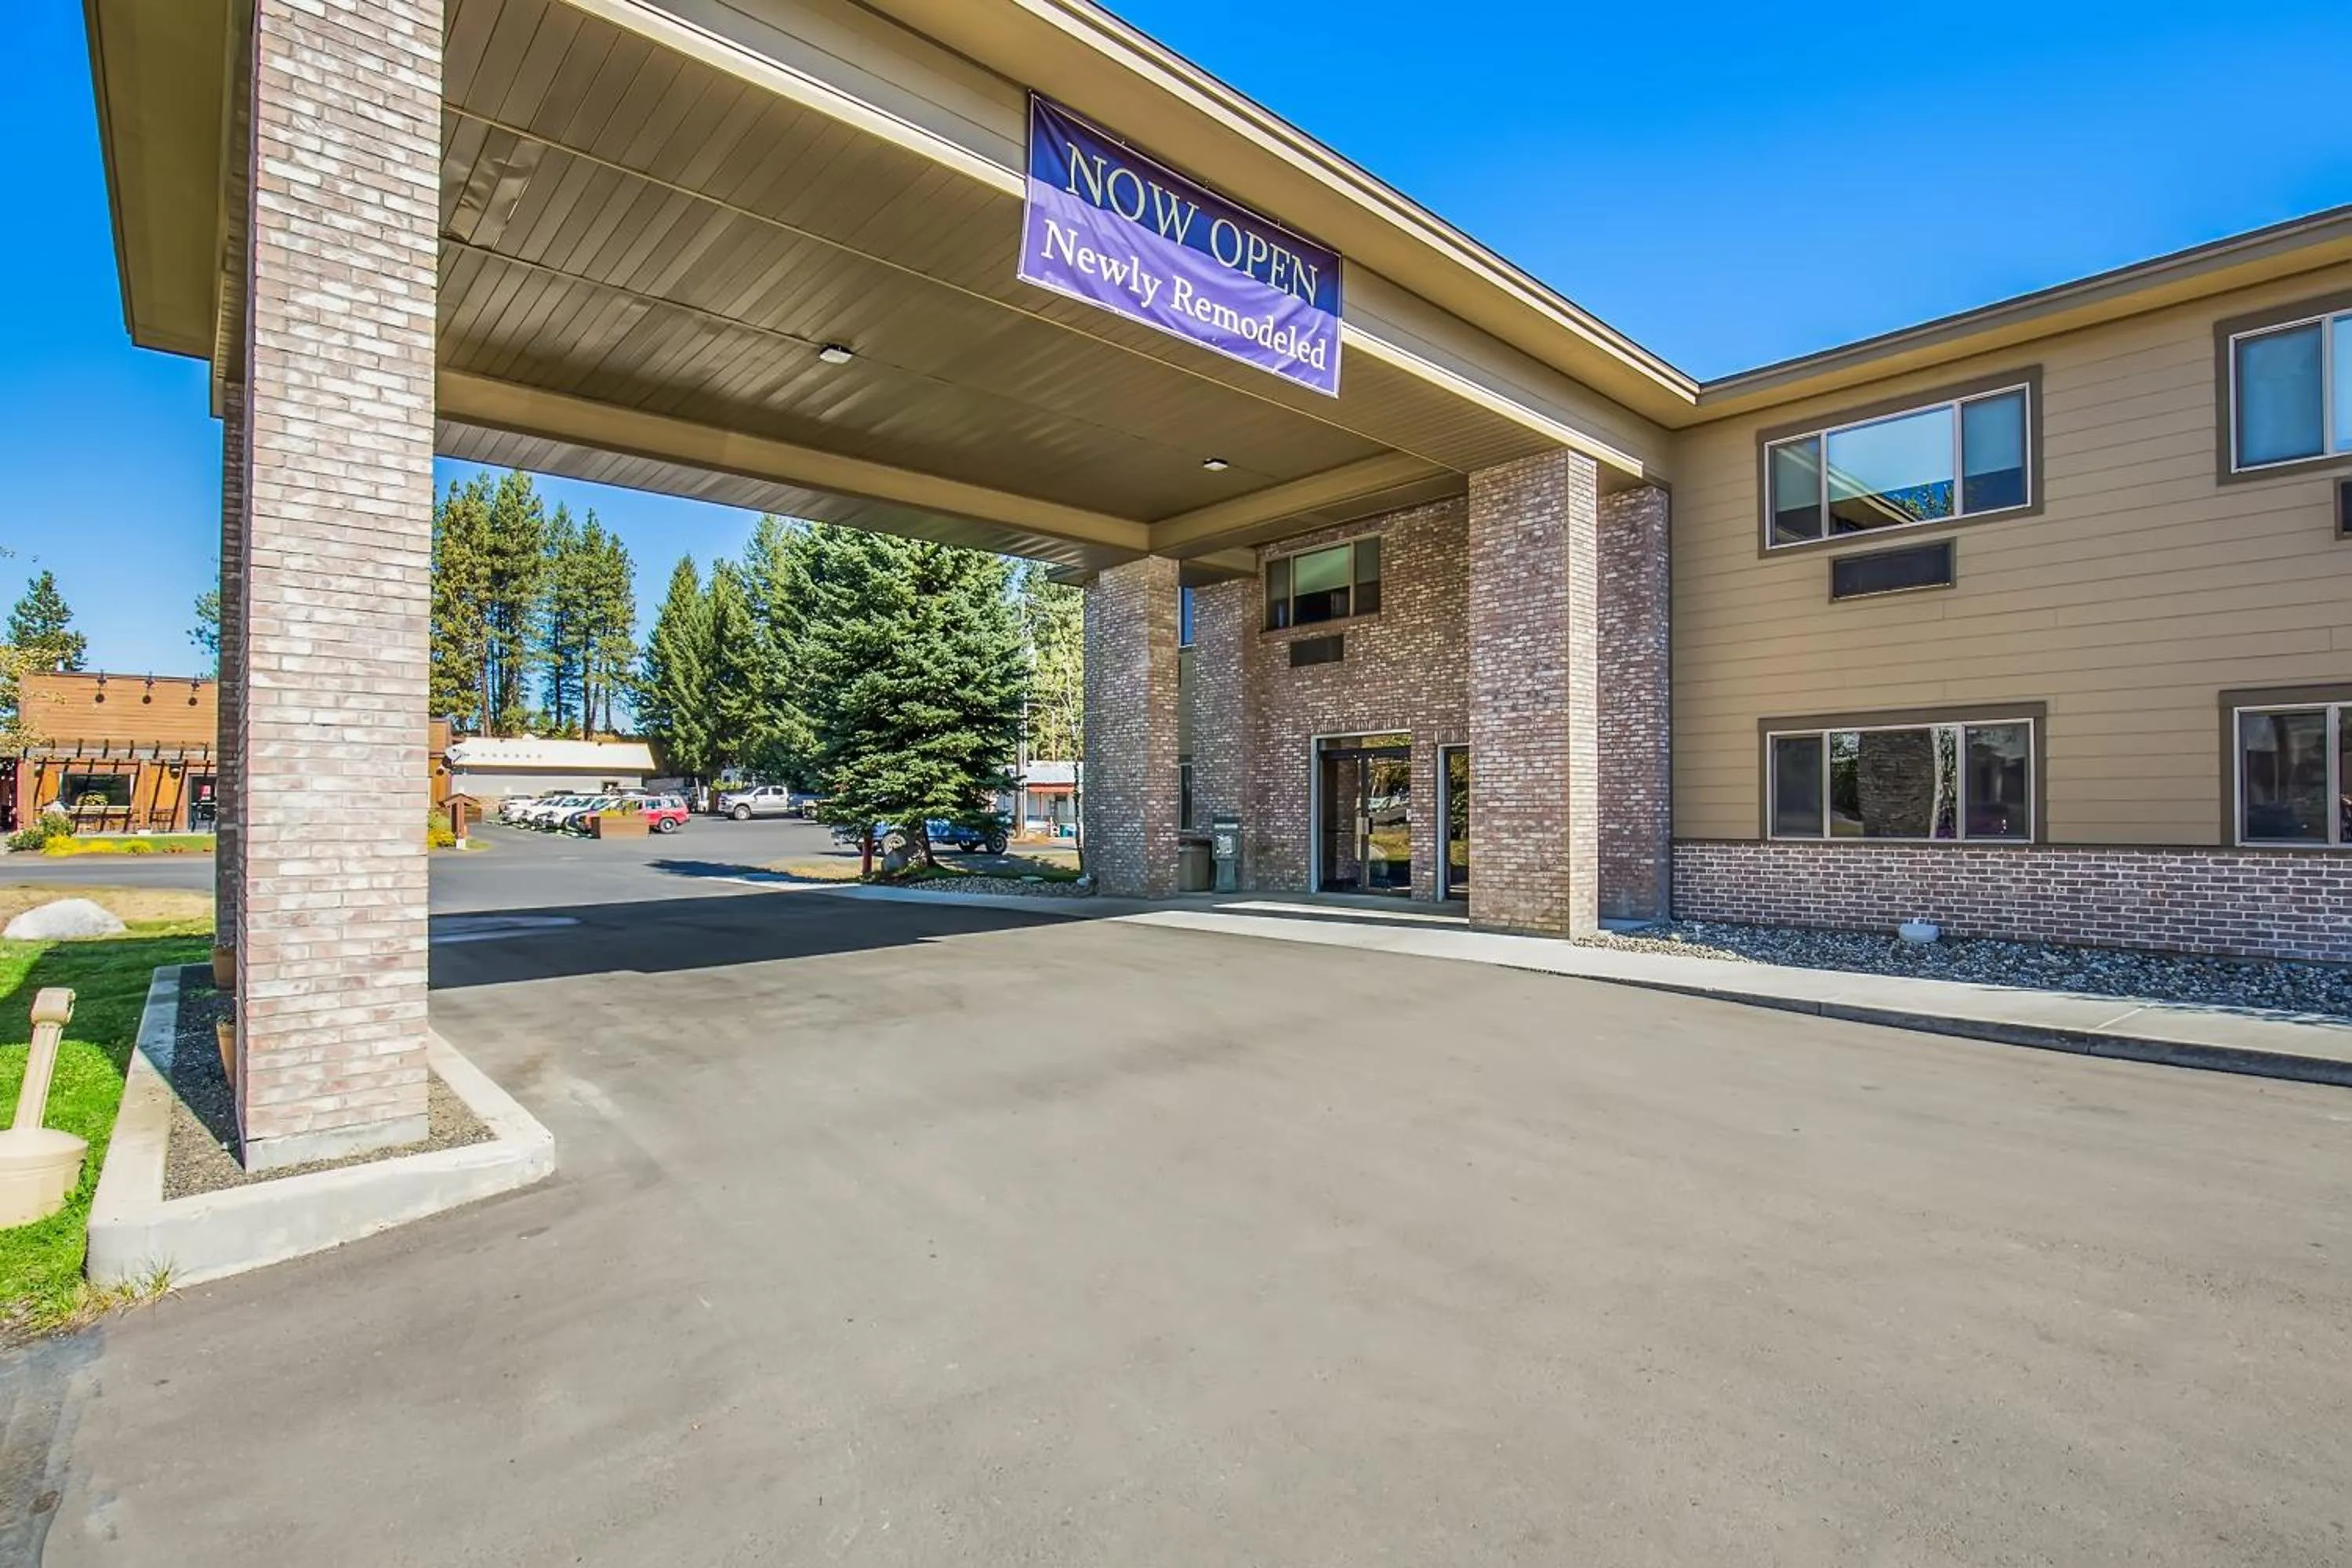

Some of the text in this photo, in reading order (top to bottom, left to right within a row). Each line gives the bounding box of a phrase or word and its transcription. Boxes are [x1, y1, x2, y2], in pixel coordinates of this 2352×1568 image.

[1041, 220, 1327, 370] Newly Remodeled
[1065, 142, 1319, 307] NOW OPEN
